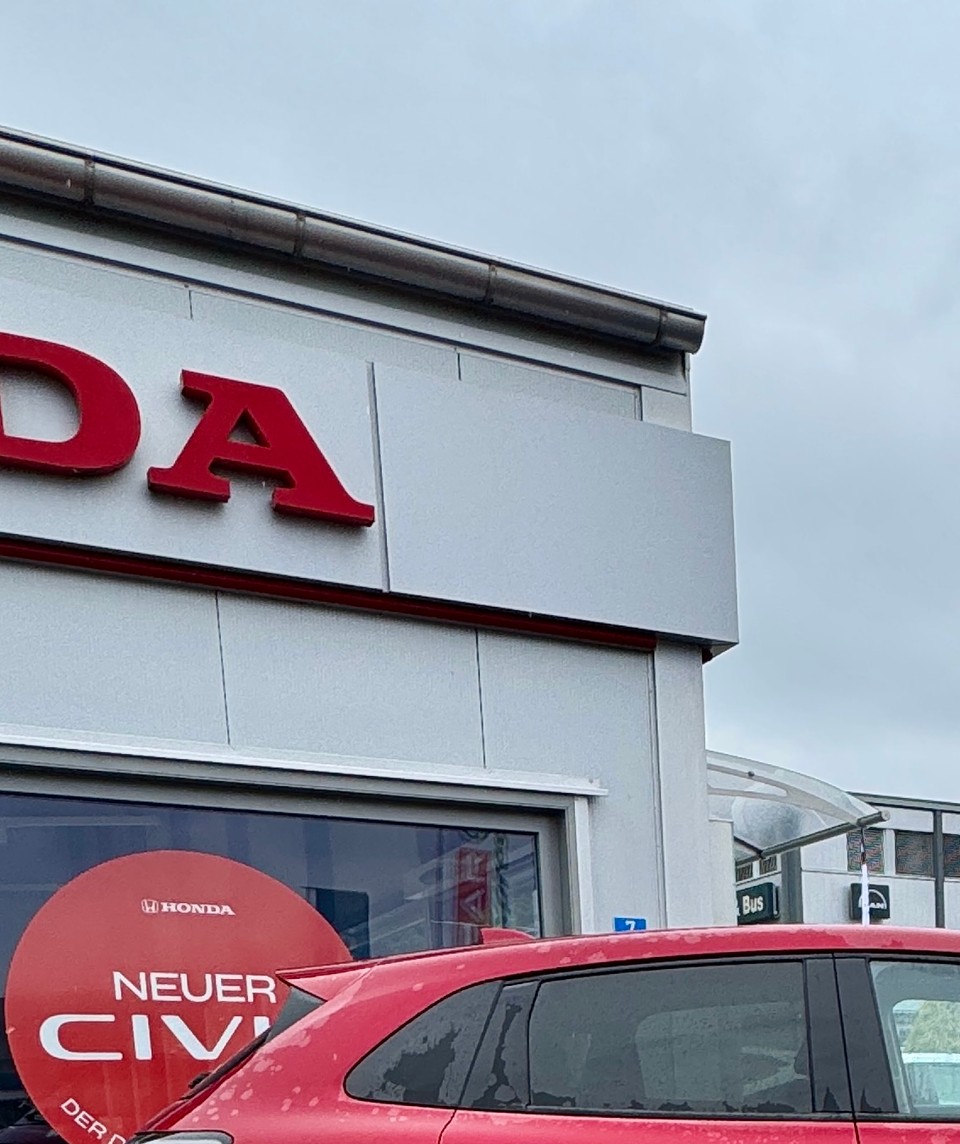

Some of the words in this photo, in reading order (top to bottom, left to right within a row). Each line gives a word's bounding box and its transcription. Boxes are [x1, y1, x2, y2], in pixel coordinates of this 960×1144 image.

[0, 331, 375, 528] DA
[160, 901, 236, 916] HONDA
[742, 895, 764, 915] Bus
[625, 919, 636, 931] 7
[112, 971, 277, 1004] NEUER
[60, 1097, 108, 1141] DER
